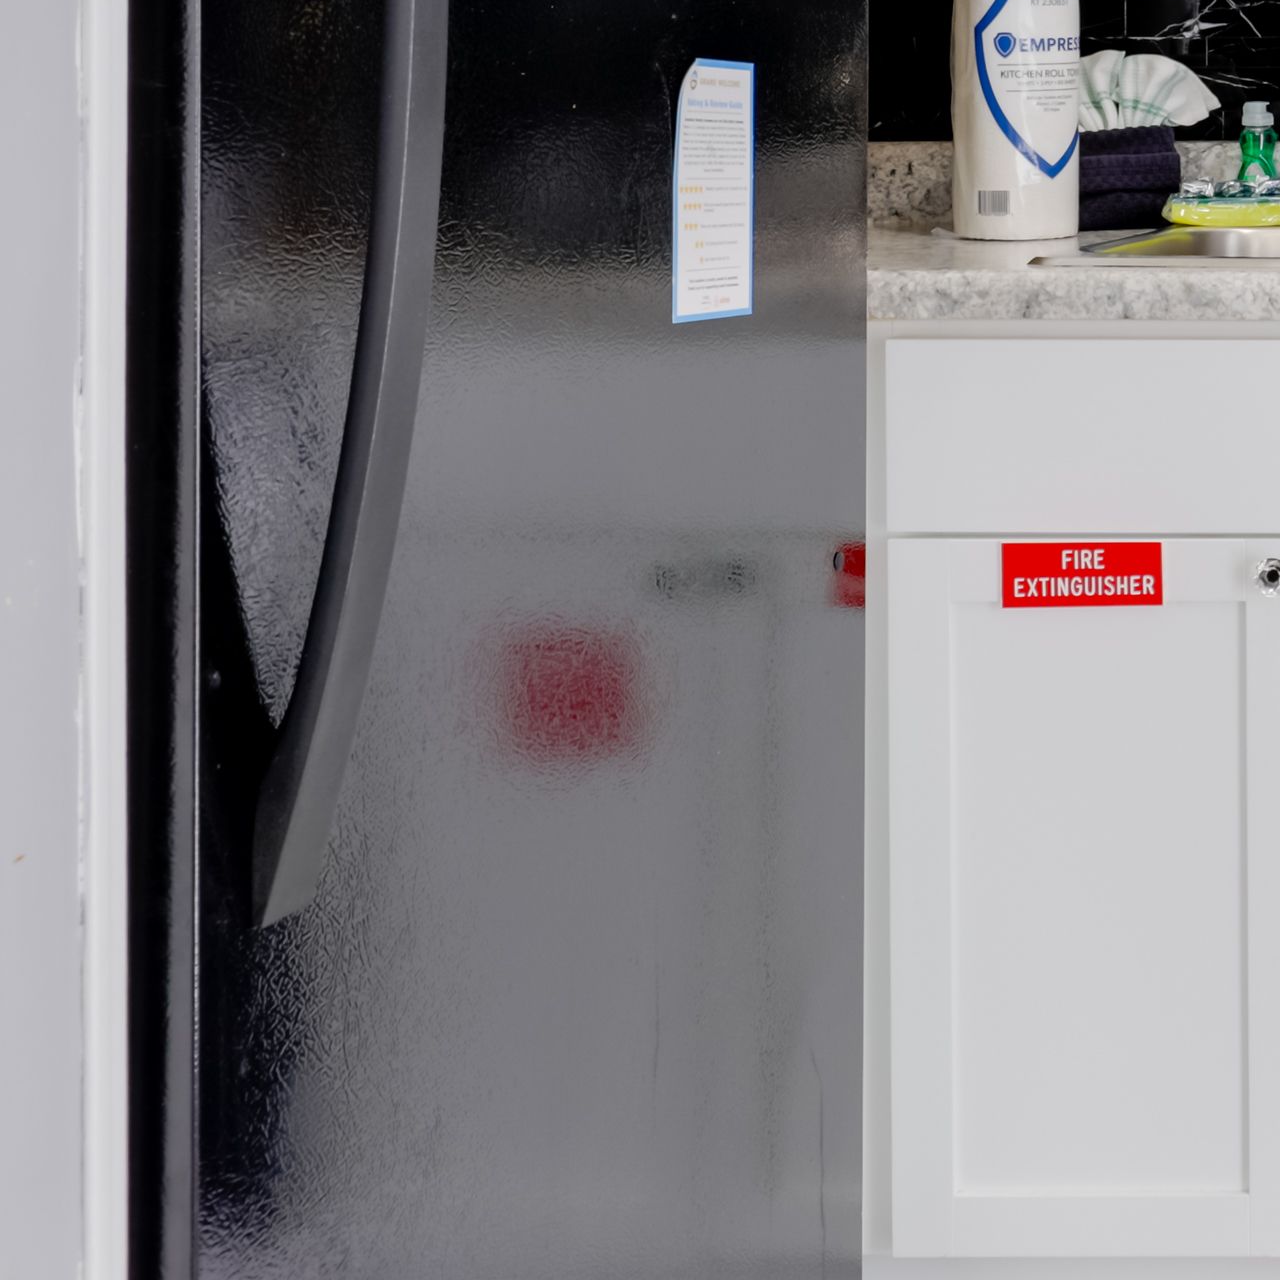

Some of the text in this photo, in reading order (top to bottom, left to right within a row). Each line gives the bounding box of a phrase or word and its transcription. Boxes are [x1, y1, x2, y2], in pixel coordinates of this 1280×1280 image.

[1000, 69, 1043, 79] KITCHEN
[1045, 68, 1065, 78] ROLL
[1061, 548, 1105, 570] FIRE
[1013, 574, 1156, 599] EXTINGUISHER
